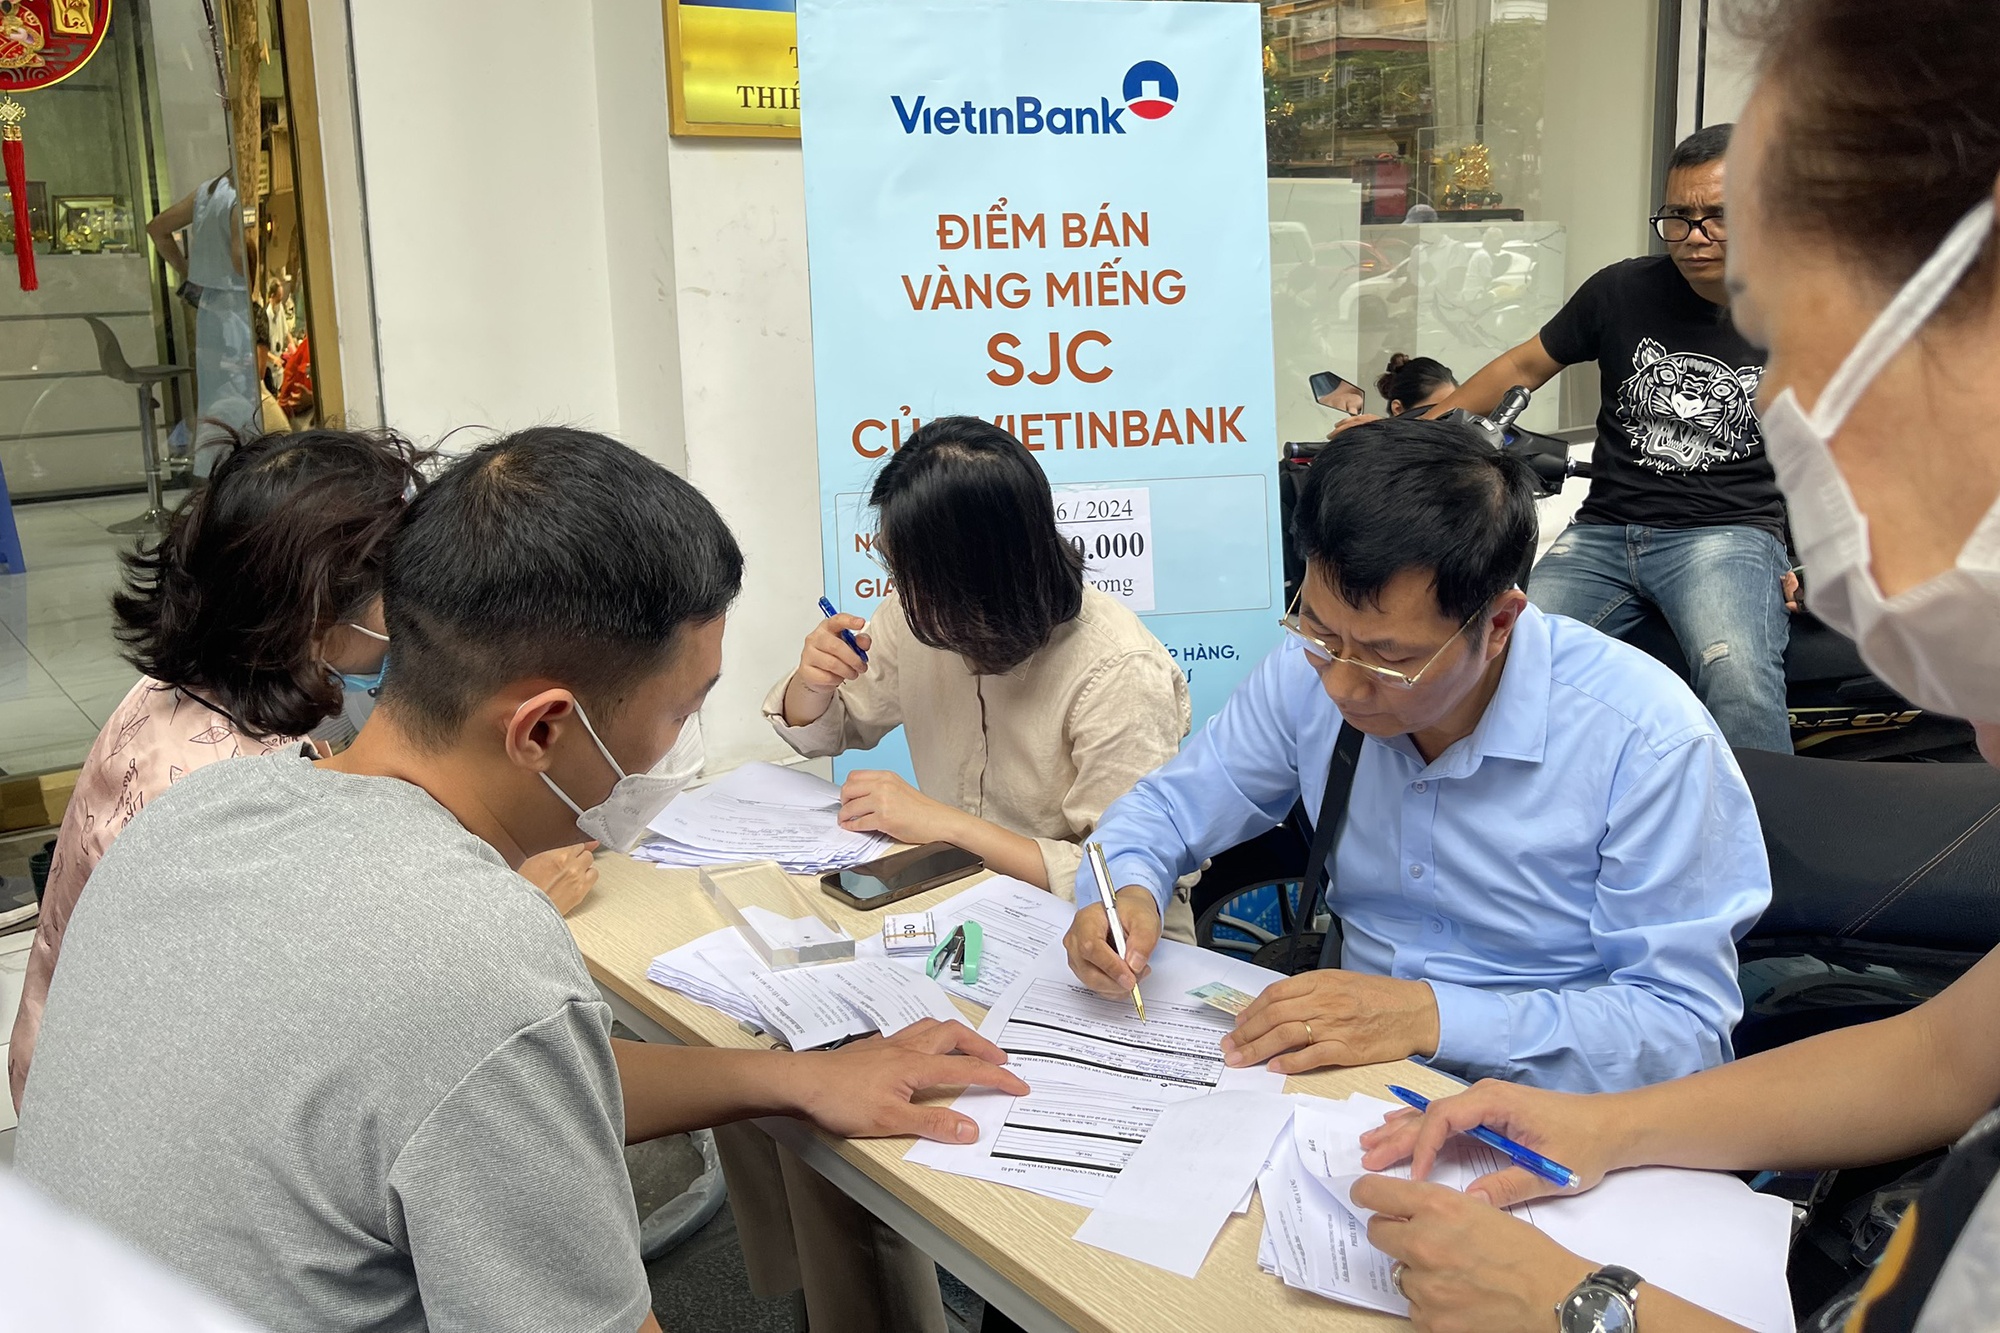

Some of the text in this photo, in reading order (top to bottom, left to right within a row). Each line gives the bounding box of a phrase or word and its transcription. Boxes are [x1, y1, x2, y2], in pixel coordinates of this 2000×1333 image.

[891, 95, 1125, 135] VietinBank
[936, 197, 1149, 251] ĐIỂM BÁN
[901, 257, 1187, 311] VÀNG MIẾNG
[986, 330, 1114, 387] SJC
[852, 405, 1247, 459] CỦ IETINBANK
[1086, 499, 1133, 519] 2024
[1070, 531, 1145, 560] 0.000
[1183, 642, 1240, 662] HÀNG,
